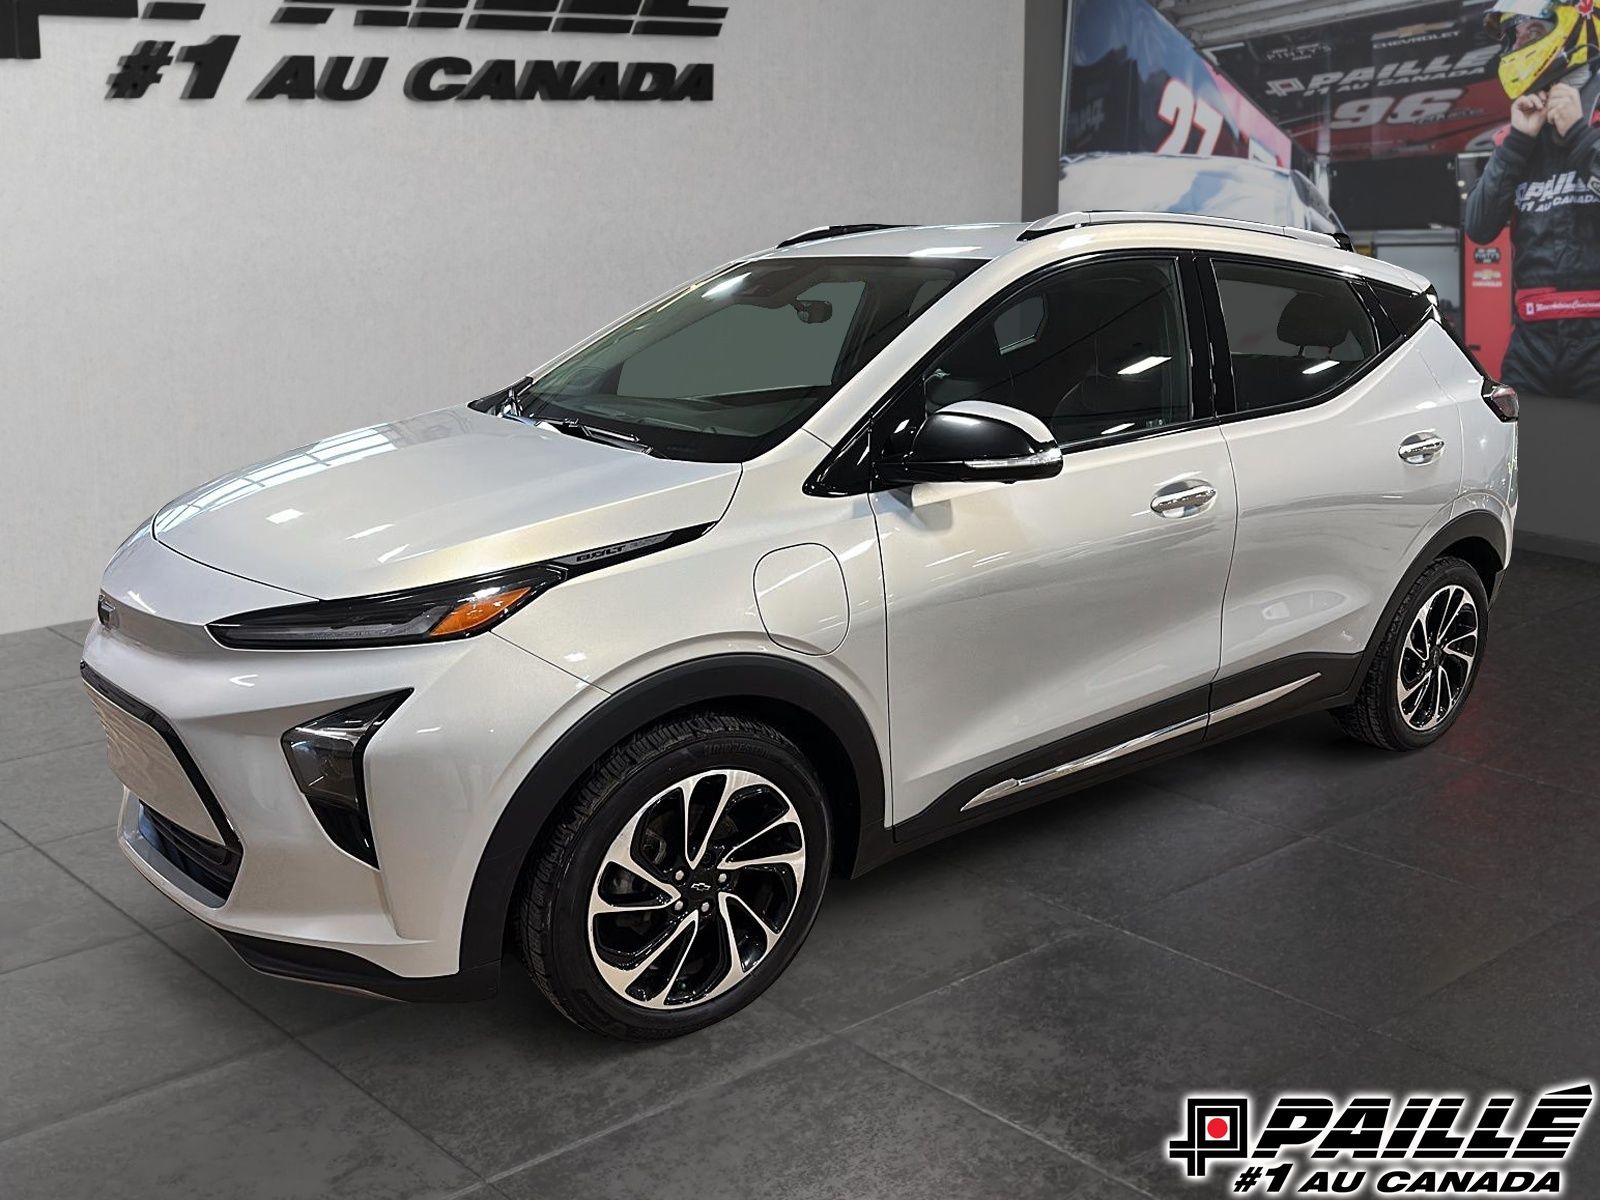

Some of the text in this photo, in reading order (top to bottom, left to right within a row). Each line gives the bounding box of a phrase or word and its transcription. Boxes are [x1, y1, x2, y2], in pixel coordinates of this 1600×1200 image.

[1372, 30, 1461, 50] CHEVROLET
[104, 34, 714, 101] #1 AU CANADA
[1336, 82, 1370, 93] AU
[1377, 67, 1485, 87] CANADA
[1156, 78, 1224, 157] 27
[1331, 88, 1464, 129] 96
